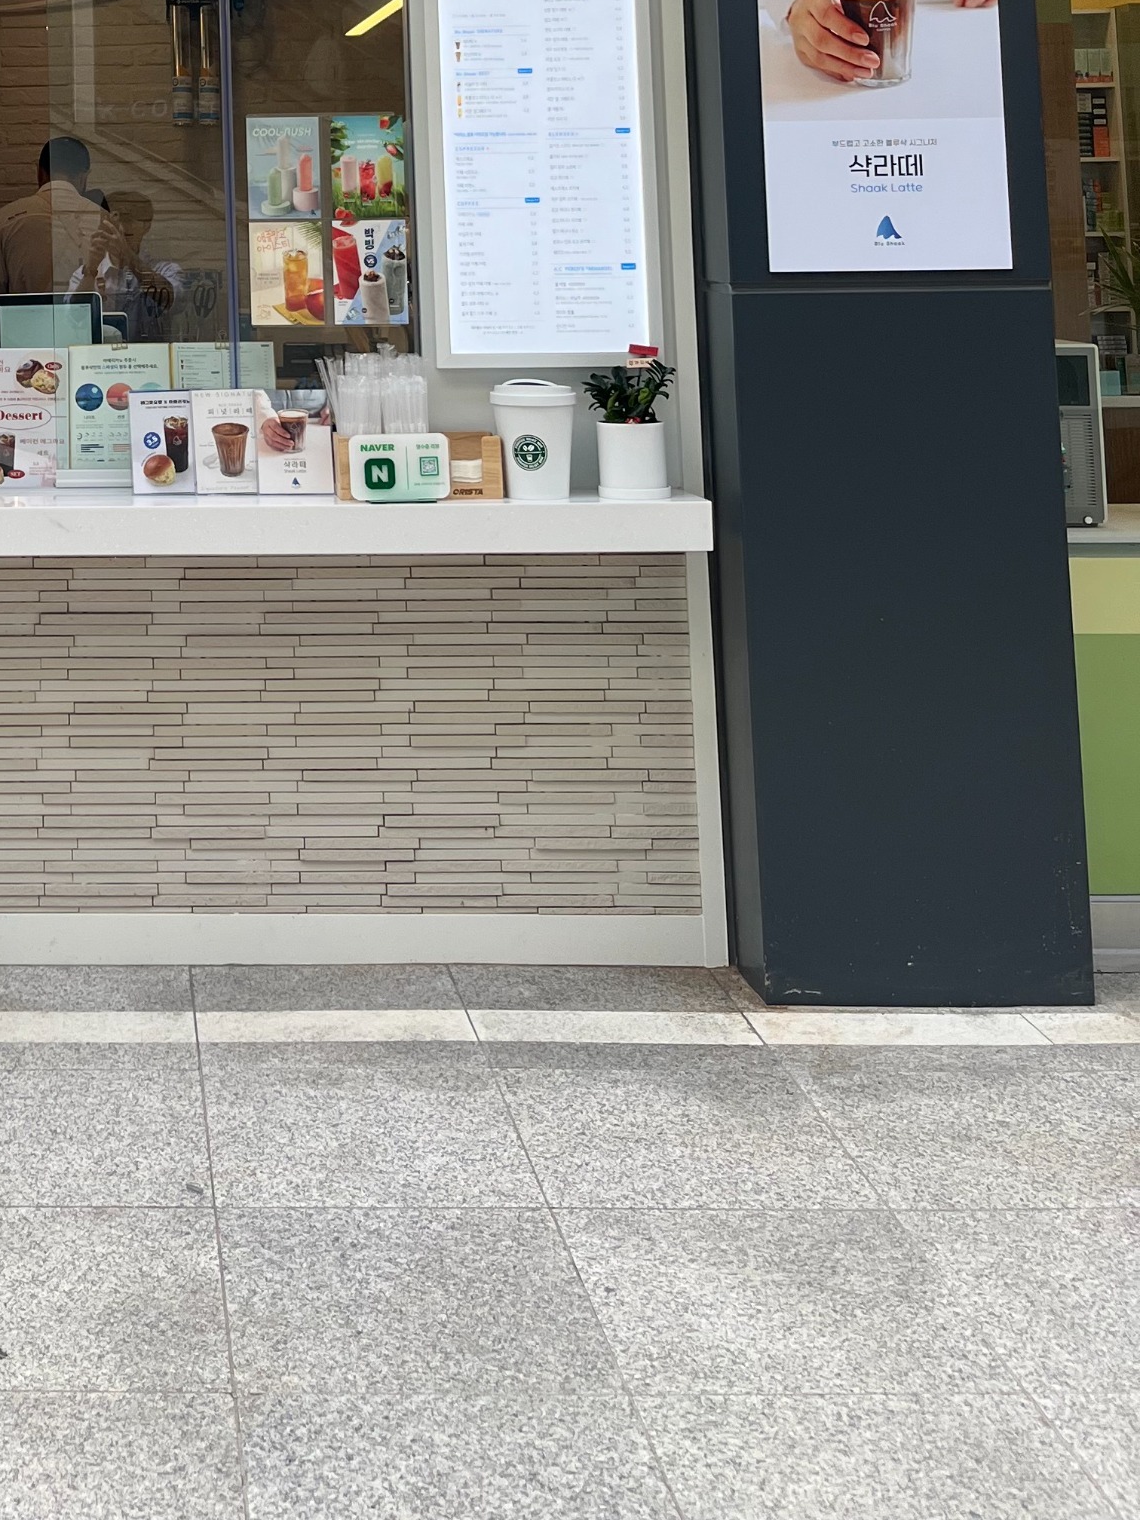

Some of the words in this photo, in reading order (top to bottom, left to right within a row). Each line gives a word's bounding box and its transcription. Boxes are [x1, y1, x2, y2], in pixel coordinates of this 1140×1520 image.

[862, 139, 884, 147] 고소한
[848, 153, 924, 178] 샥라떼
[850, 183, 888, 193] Shaak
[890, 182, 923, 193] Latte
[360, 443, 395, 452] NAVER
[371, 464, 389, 483] N
[452, 488, 484, 496] ORISTA
